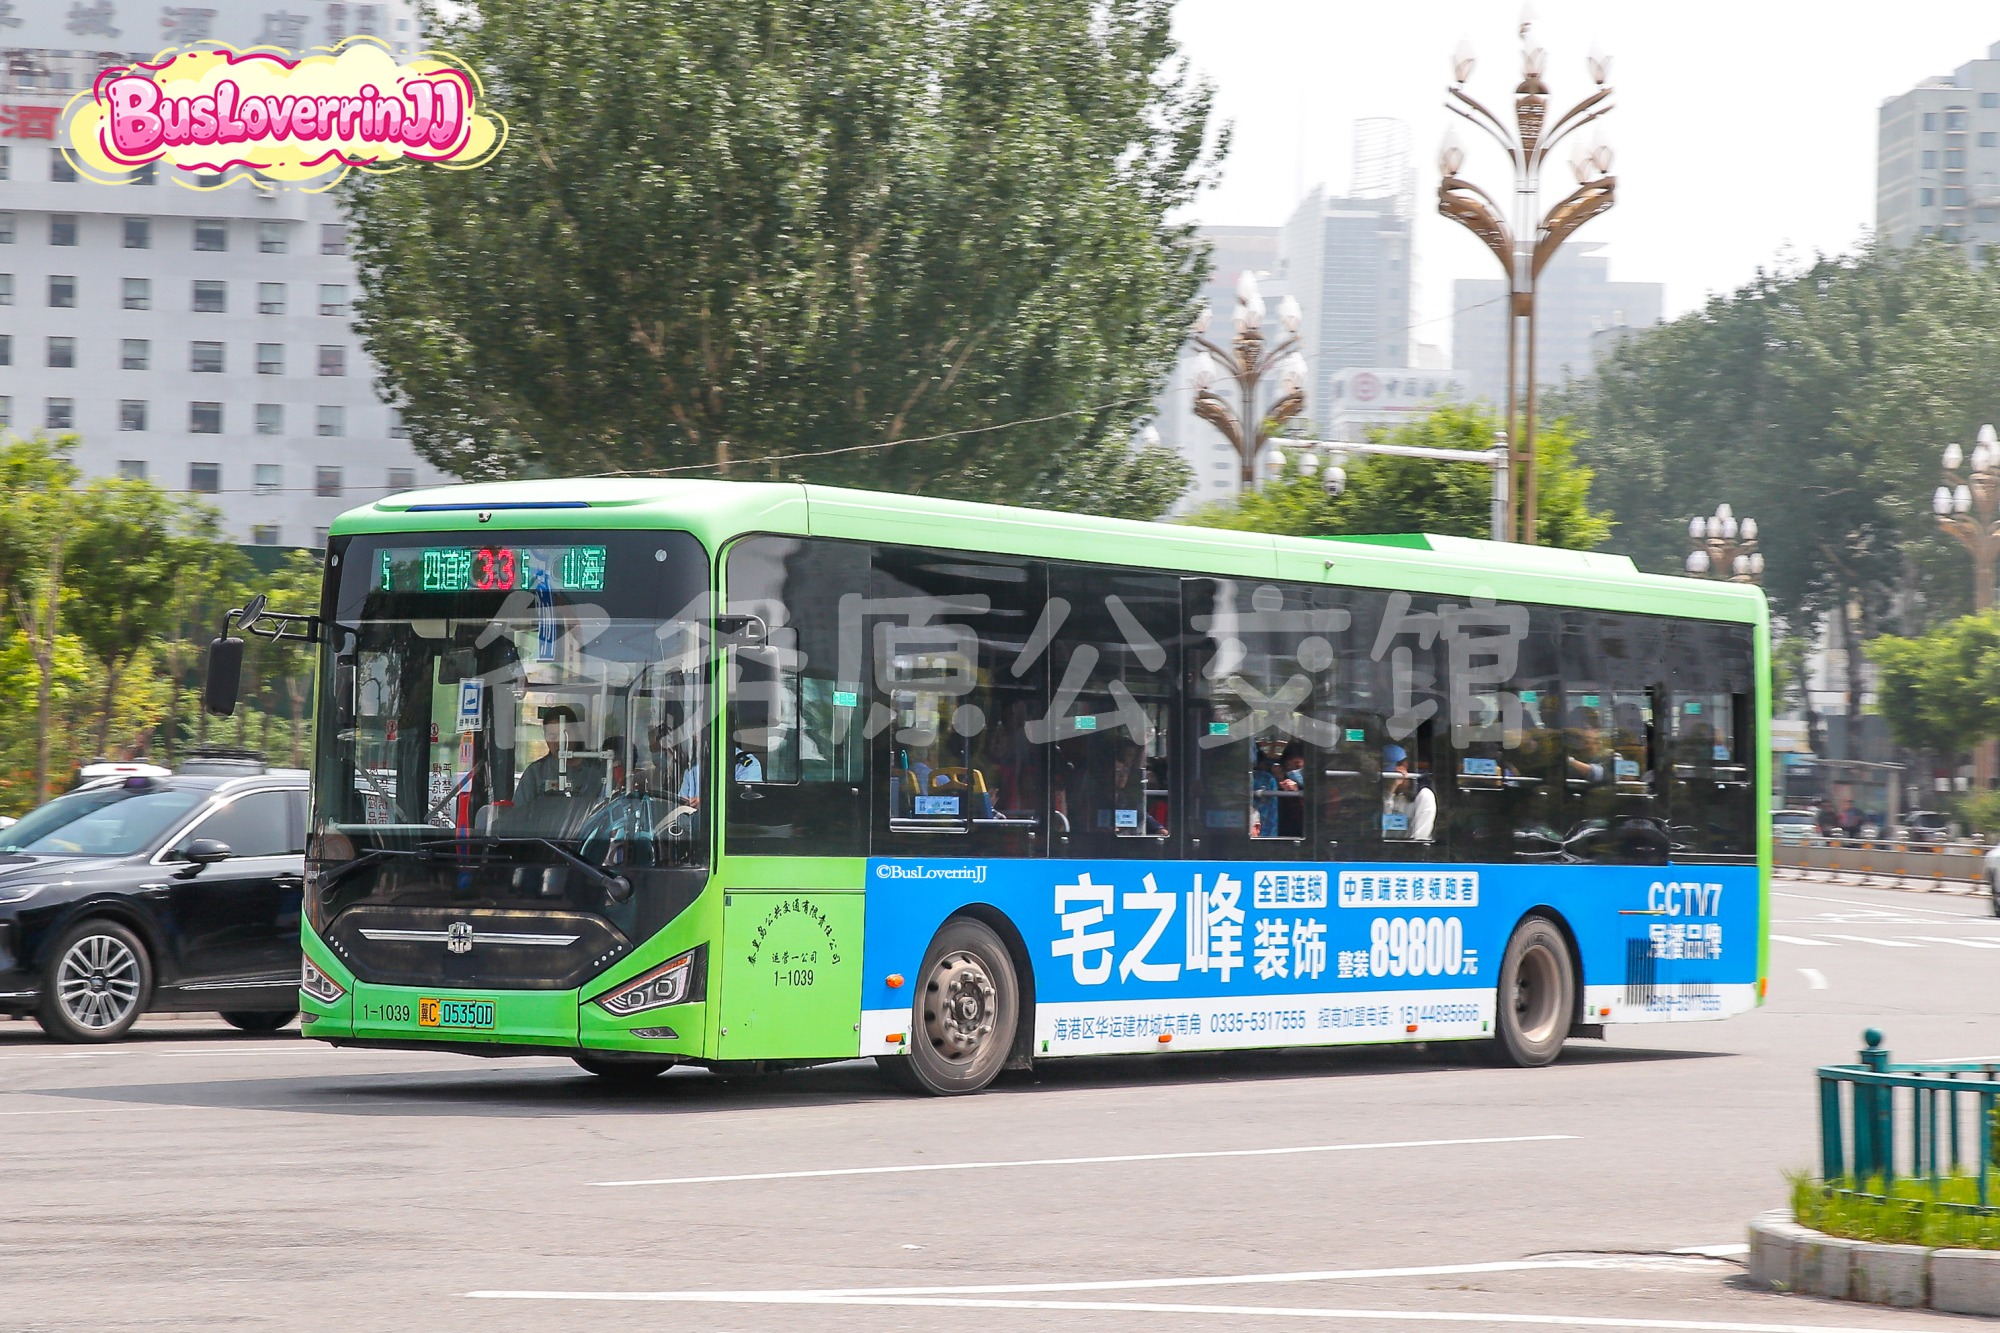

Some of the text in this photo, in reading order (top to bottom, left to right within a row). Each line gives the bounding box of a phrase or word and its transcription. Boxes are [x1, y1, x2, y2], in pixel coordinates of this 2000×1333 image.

[477, 549, 516, 590] 33
[1257, 875, 1323, 903] 全国连锁
[1343, 876, 1475, 902] 中高端装修领跑者
[1648, 881, 1723, 917] CCTV7
[1051, 872, 1245, 985] 宅之峰
[772, 950, 818, 965] 运营一公司
[1253, 917, 1328, 981] 装饰
[774, 969, 815, 986] 1-1039
[363, 1003, 410, 1022] 1-1039
[1053, 1013, 1202, 1041] 海港区华运建材城东南角
[1210, 1009, 1306, 1033] 0335-5317555
